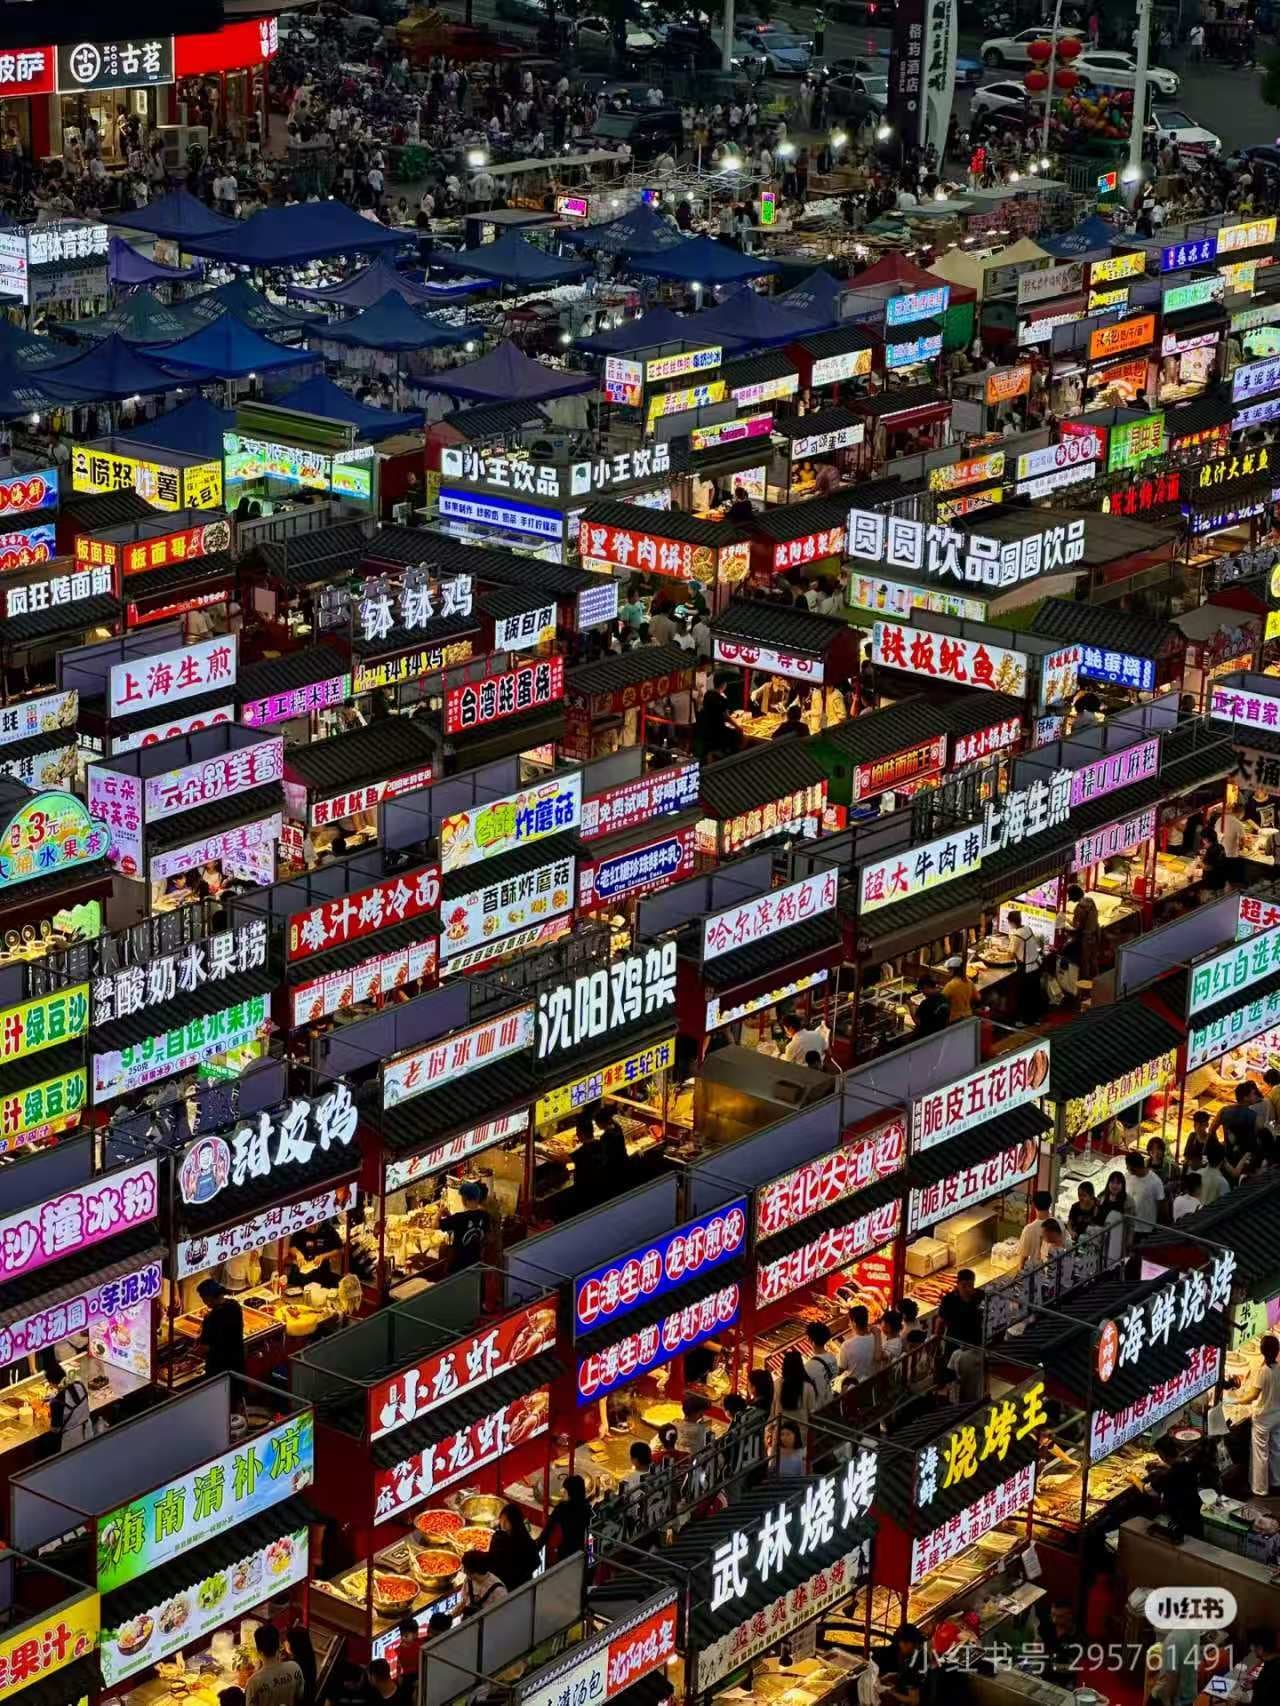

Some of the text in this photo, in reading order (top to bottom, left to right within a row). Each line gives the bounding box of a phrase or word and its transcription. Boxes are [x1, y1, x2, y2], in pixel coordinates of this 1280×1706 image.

[120, 42, 162, 75] 古茗
[468, 449, 559, 497] 小王饮品
[594, 442, 670, 489] 小王饮品
[76, 538, 117, 566] 板面哥
[130, 536, 187, 571] 板面哥
[590, 528, 682, 577] 里脊肉饼
[849, 508, 1000, 586] 圆圆饮品
[999, 519, 1085, 588] 圆圆饮品
[6, 565, 112, 618] 疯狂烤面筋
[360, 573, 475, 641] 钵钵鸡
[504, 608, 553, 641] 锅包肉
[116, 646, 233, 706] 上海生煎
[880, 624, 1000, 691] 铁板鱿鱼
[460, 664, 551, 727] 台湾蚝蛋烧
[104, 776, 136, 800] 云朵
[160, 743, 276, 813] 云朵舒芙蕾
[984, 768, 1073, 850] 上海生煎
[482, 862, 570, 915] 香酥炸蘑菇
[863, 832, 980, 906] 超大牛肉串
[300, 868, 440, 951] 爆汁烤冷面
[706, 872, 836, 951] 哈尔滨锅包肉
[114, 919, 267, 1020] 酸奶水果捞
[536, 940, 677, 1059] 沈阳鸡架
[0, 992, 87, 1056] 汁绿豆沙
[0, 1074, 84, 1134] 汁绿豆沙
[231, 1082, 358, 1186] 甜皮鸭
[922, 1057, 1029, 1138] 脆皮五花肉
[760, 1123, 906, 1234] 东北大油边
[920, 1143, 1019, 1219] 脆皮五花肉
[579, 1209, 743, 1322] 上海生煎 龙虾煎饺
[759, 1200, 898, 1301] 东北大油边
[579, 1284, 738, 1395] 上海生煎 龙虾煎饺
[1119, 1251, 1238, 1368] 海鲜烧烤
[379, 1329, 501, 1429] 小龙虾
[396, 1405, 512, 1503] 小龙虾
[919, 1446, 938, 1507] 海鲜
[943, 1381, 1047, 1489] 烧烤王
[112, 1426, 302, 1565] 海南清补凉
[709, 1450, 879, 1613] 武林烧烤
[608, 1620, 674, 1688] 沈阳鸡架
